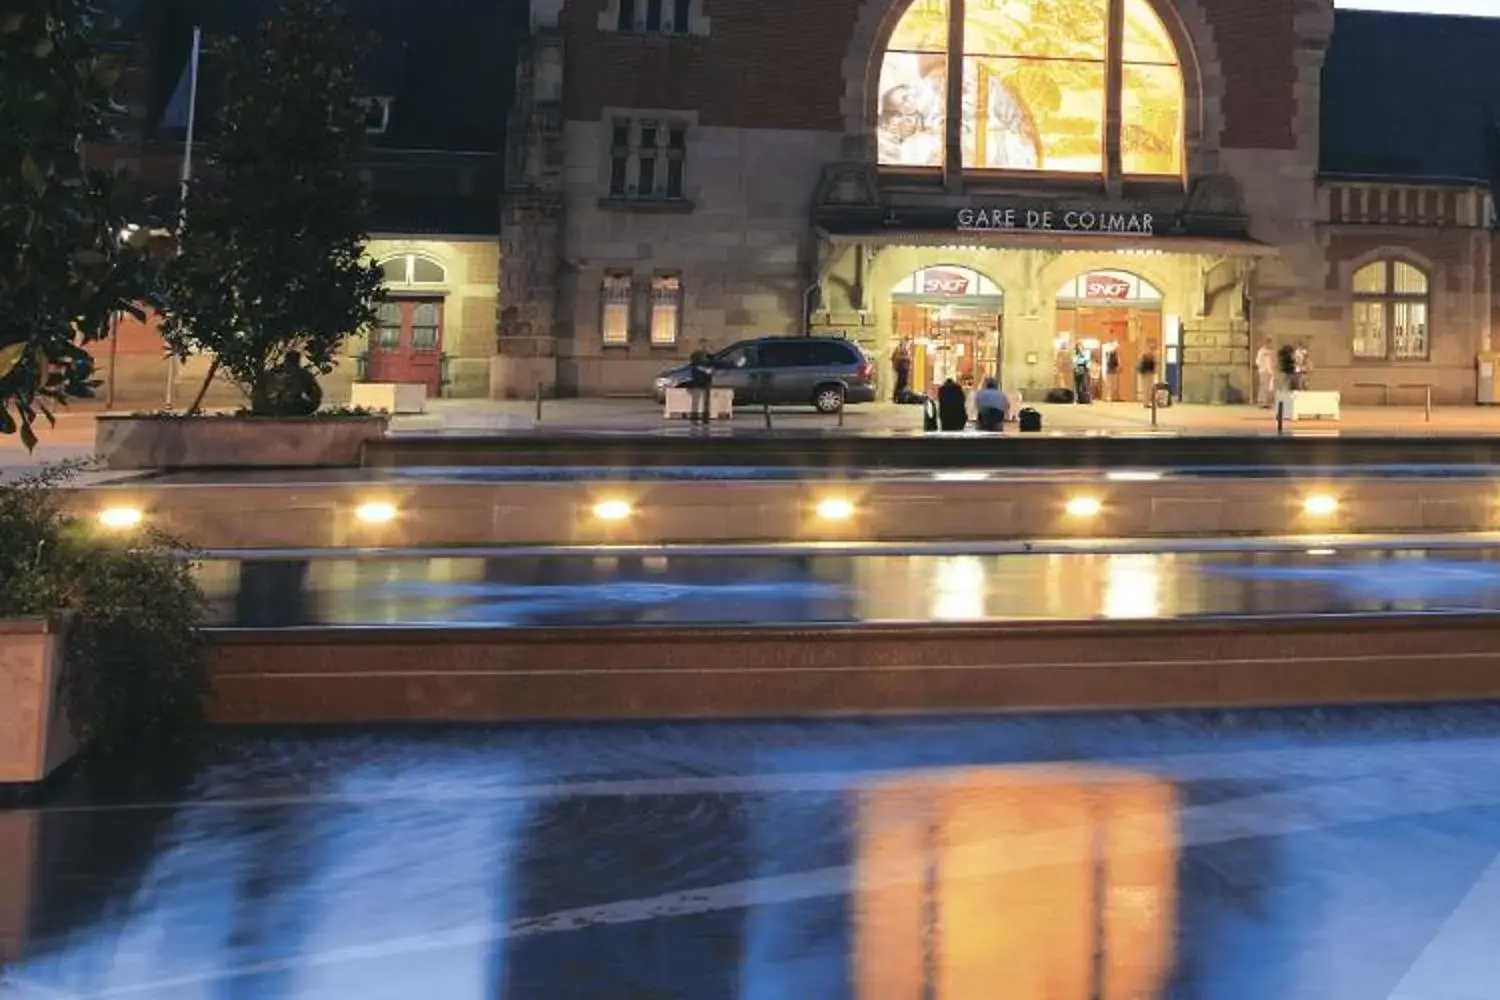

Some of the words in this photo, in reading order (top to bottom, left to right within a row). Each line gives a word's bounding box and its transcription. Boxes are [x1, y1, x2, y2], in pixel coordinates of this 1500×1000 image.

[957, 207, 1015, 226] GARE
[1027, 209, 1053, 228] DE
[1064, 210, 1154, 231] COLMAR
[925, 279, 968, 293] SNCF
[1087, 283, 1129, 296] SNCF
